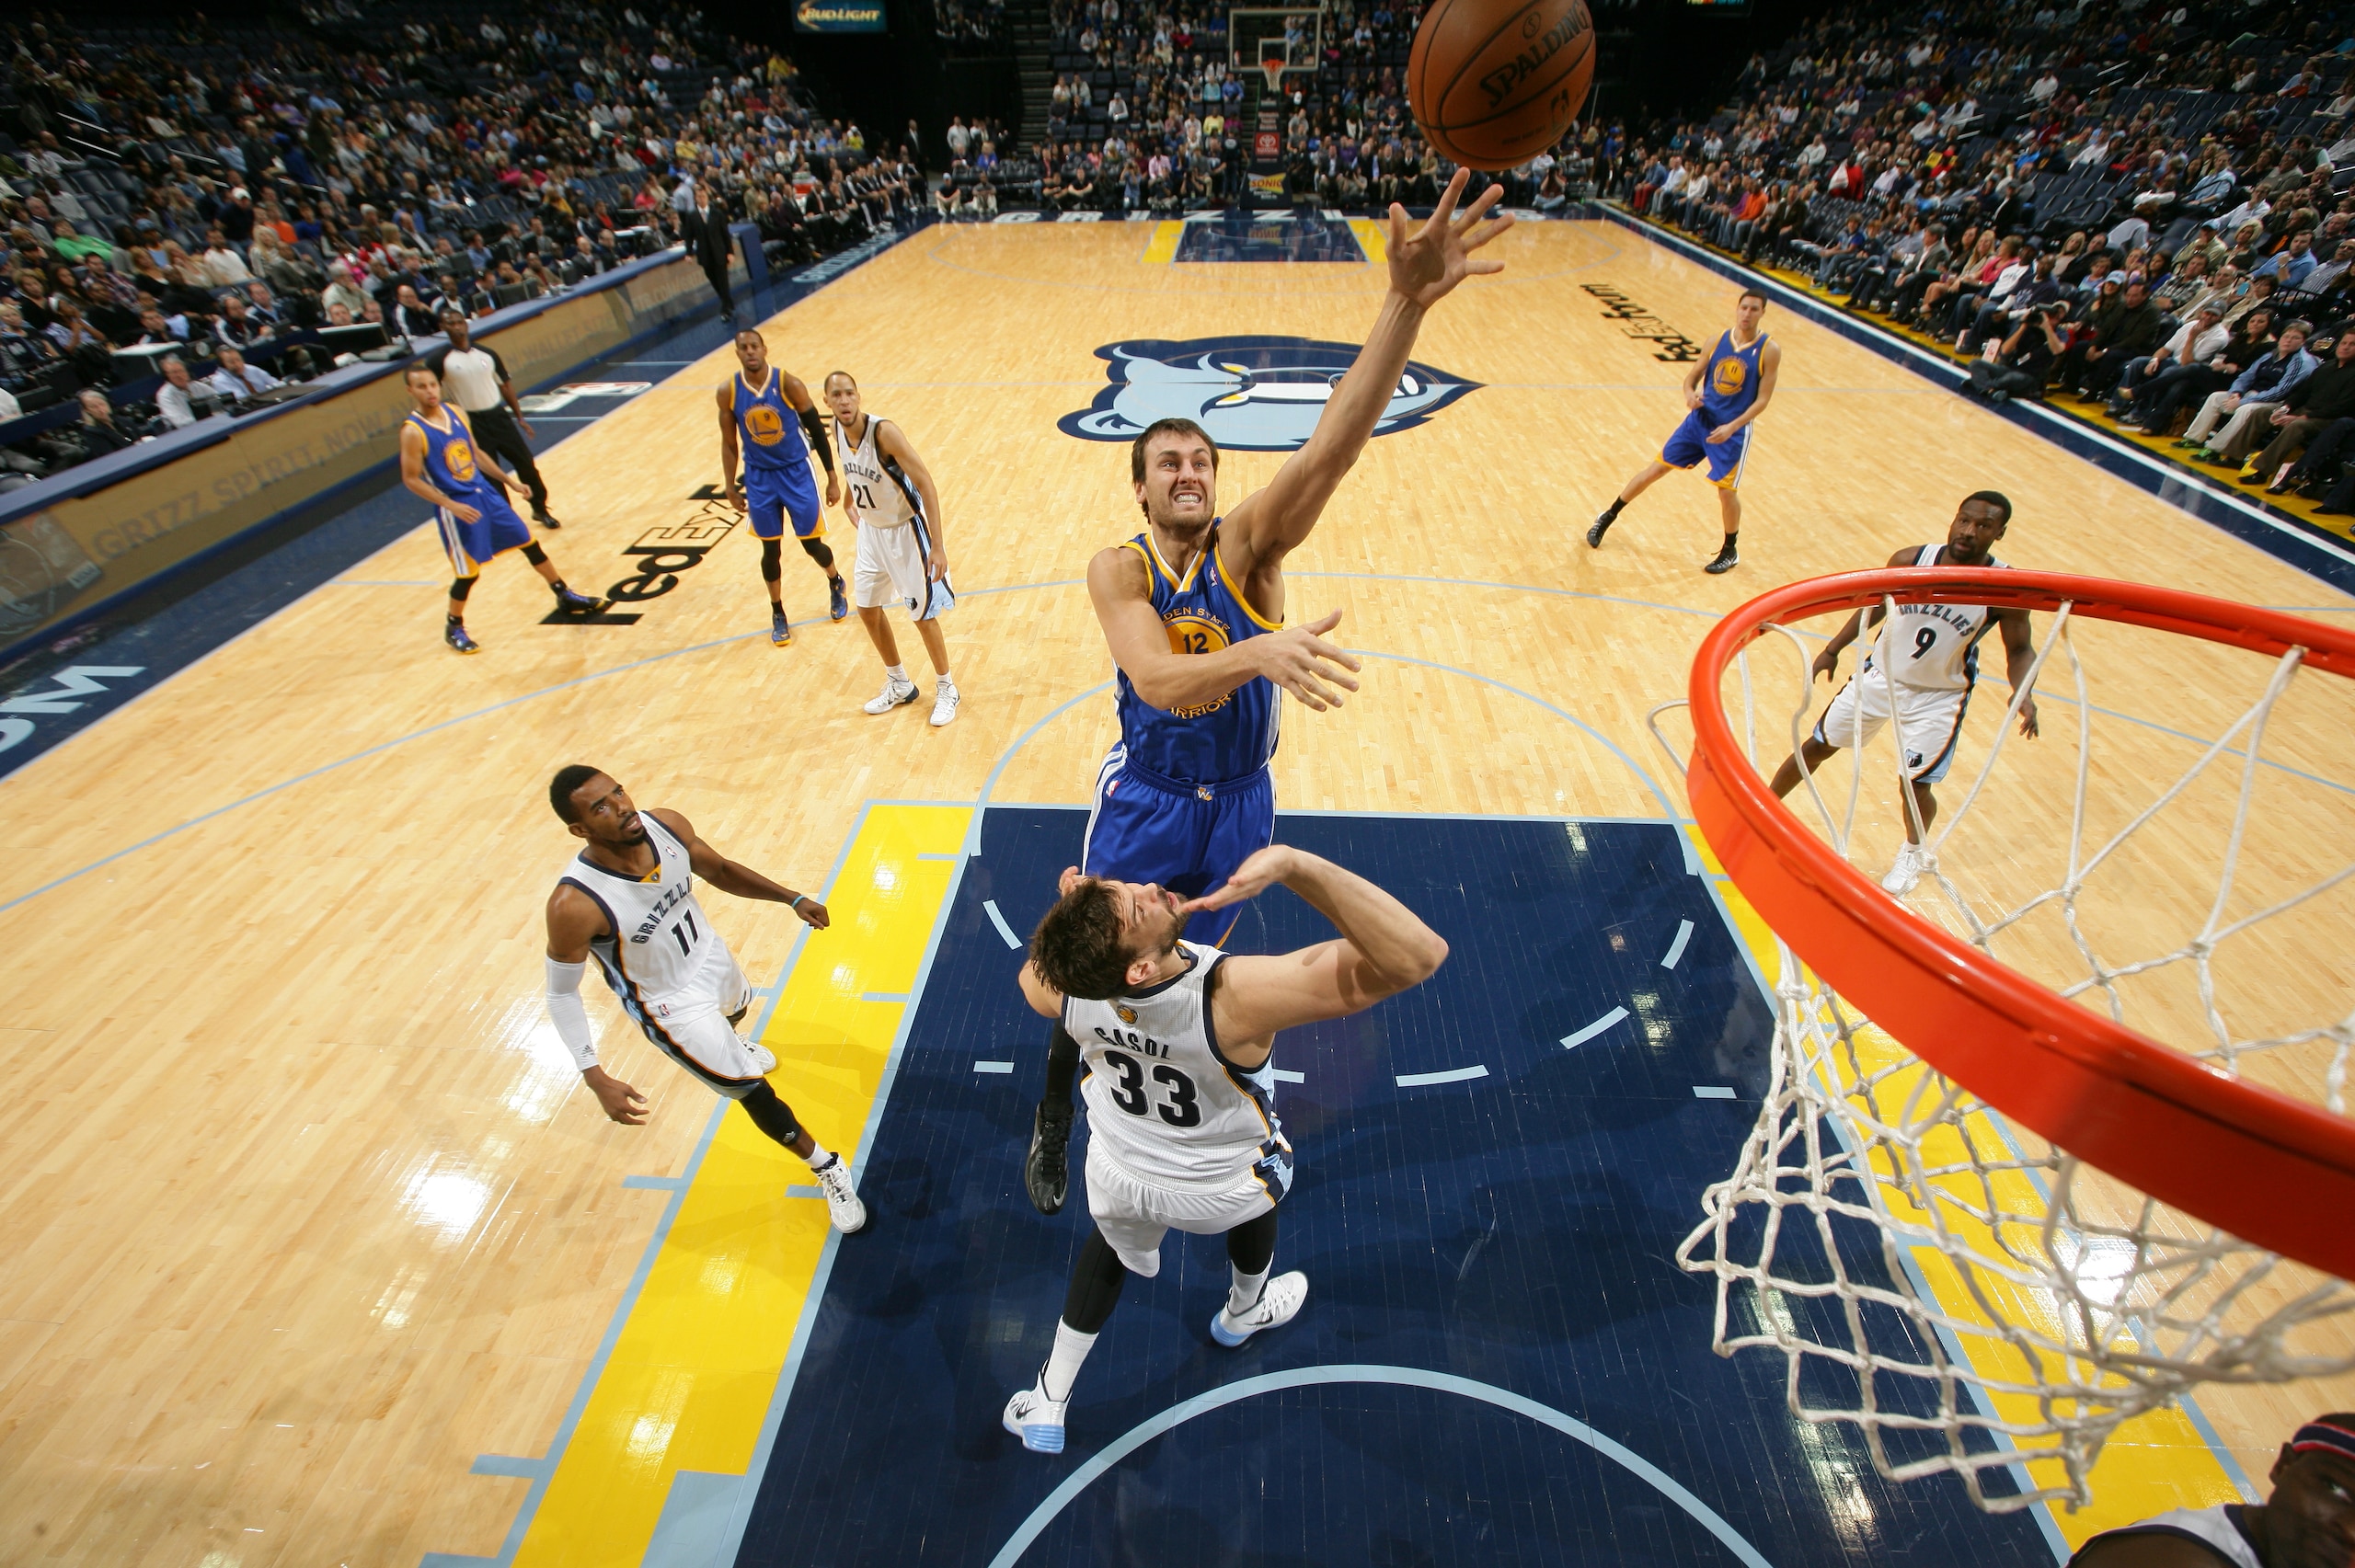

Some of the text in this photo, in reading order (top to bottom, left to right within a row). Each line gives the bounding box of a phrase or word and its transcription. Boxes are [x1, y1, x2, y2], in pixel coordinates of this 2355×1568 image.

[837, 8, 880, 22] LIGHT
[1479, 2, 1590, 109] SPALDING
[1251, 178, 1281, 188] SONIC
[993, 209, 1545, 223] GRIZZLS
[763, 411, 771, 421] 9
[853, 483, 877, 509] 21
[94, 492, 203, 562] GRIZZ
[1197, 608, 1231, 631] STATE
[1183, 632, 1209, 654] 12
[1911, 627, 1936, 659] 9
[670, 907, 699, 958] 11
[1094, 1027, 1170, 1059] GASOL
[1104, 1050, 1201, 1127] 33
